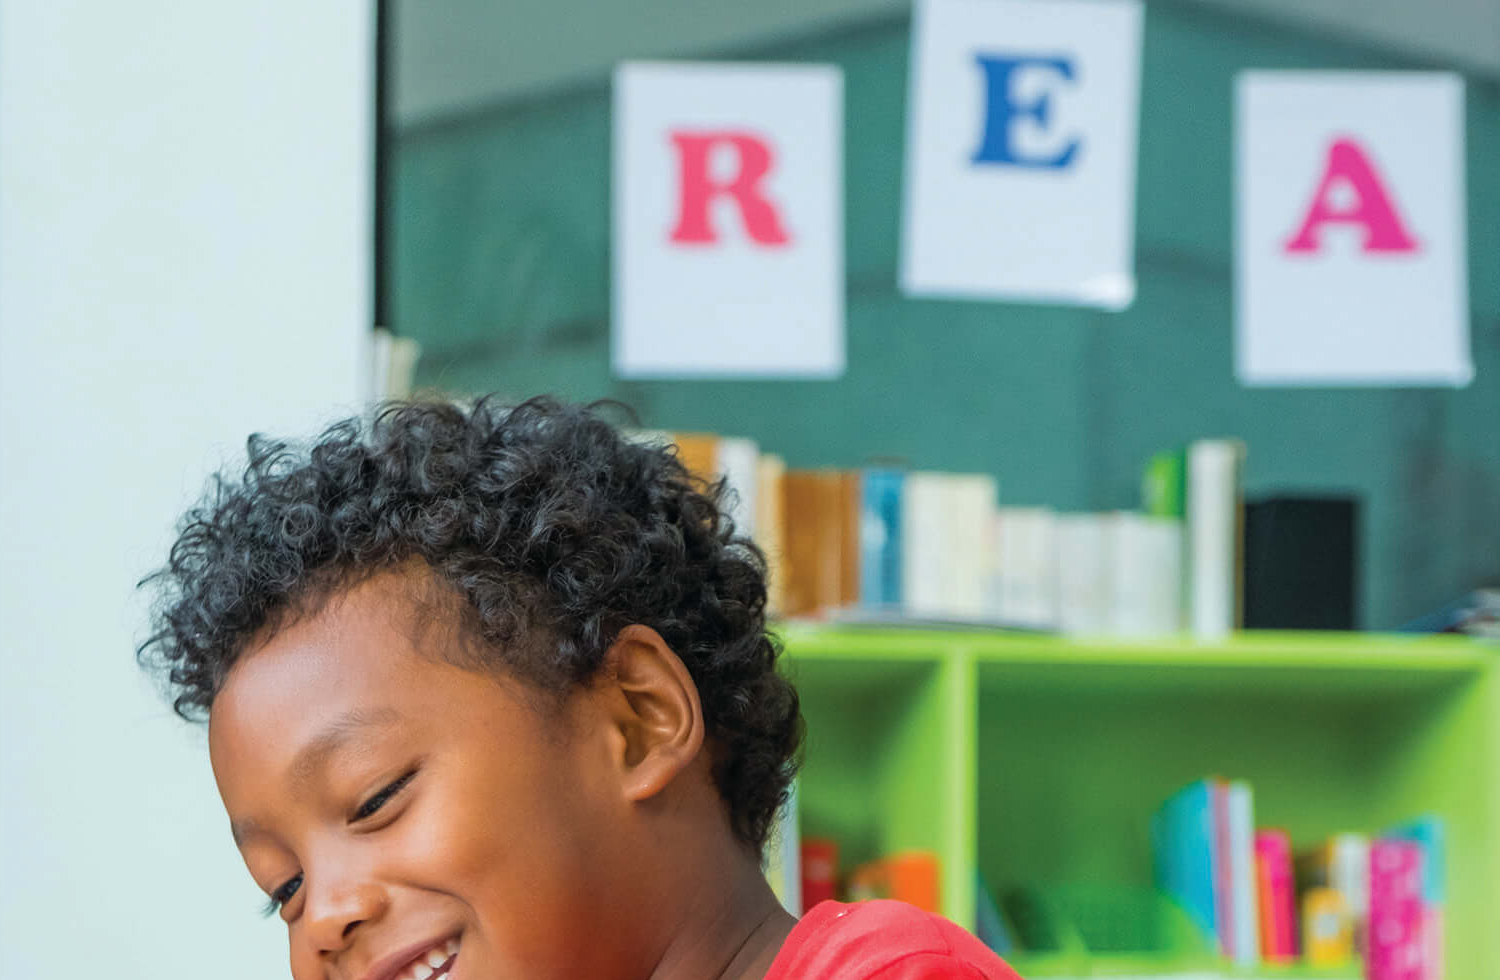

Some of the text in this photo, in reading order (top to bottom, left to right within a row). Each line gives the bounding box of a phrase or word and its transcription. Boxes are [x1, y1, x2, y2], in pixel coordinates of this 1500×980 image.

[968, 51, 1082, 172] E
[669, 132, 790, 247] R
[1284, 138, 1419, 254] A
